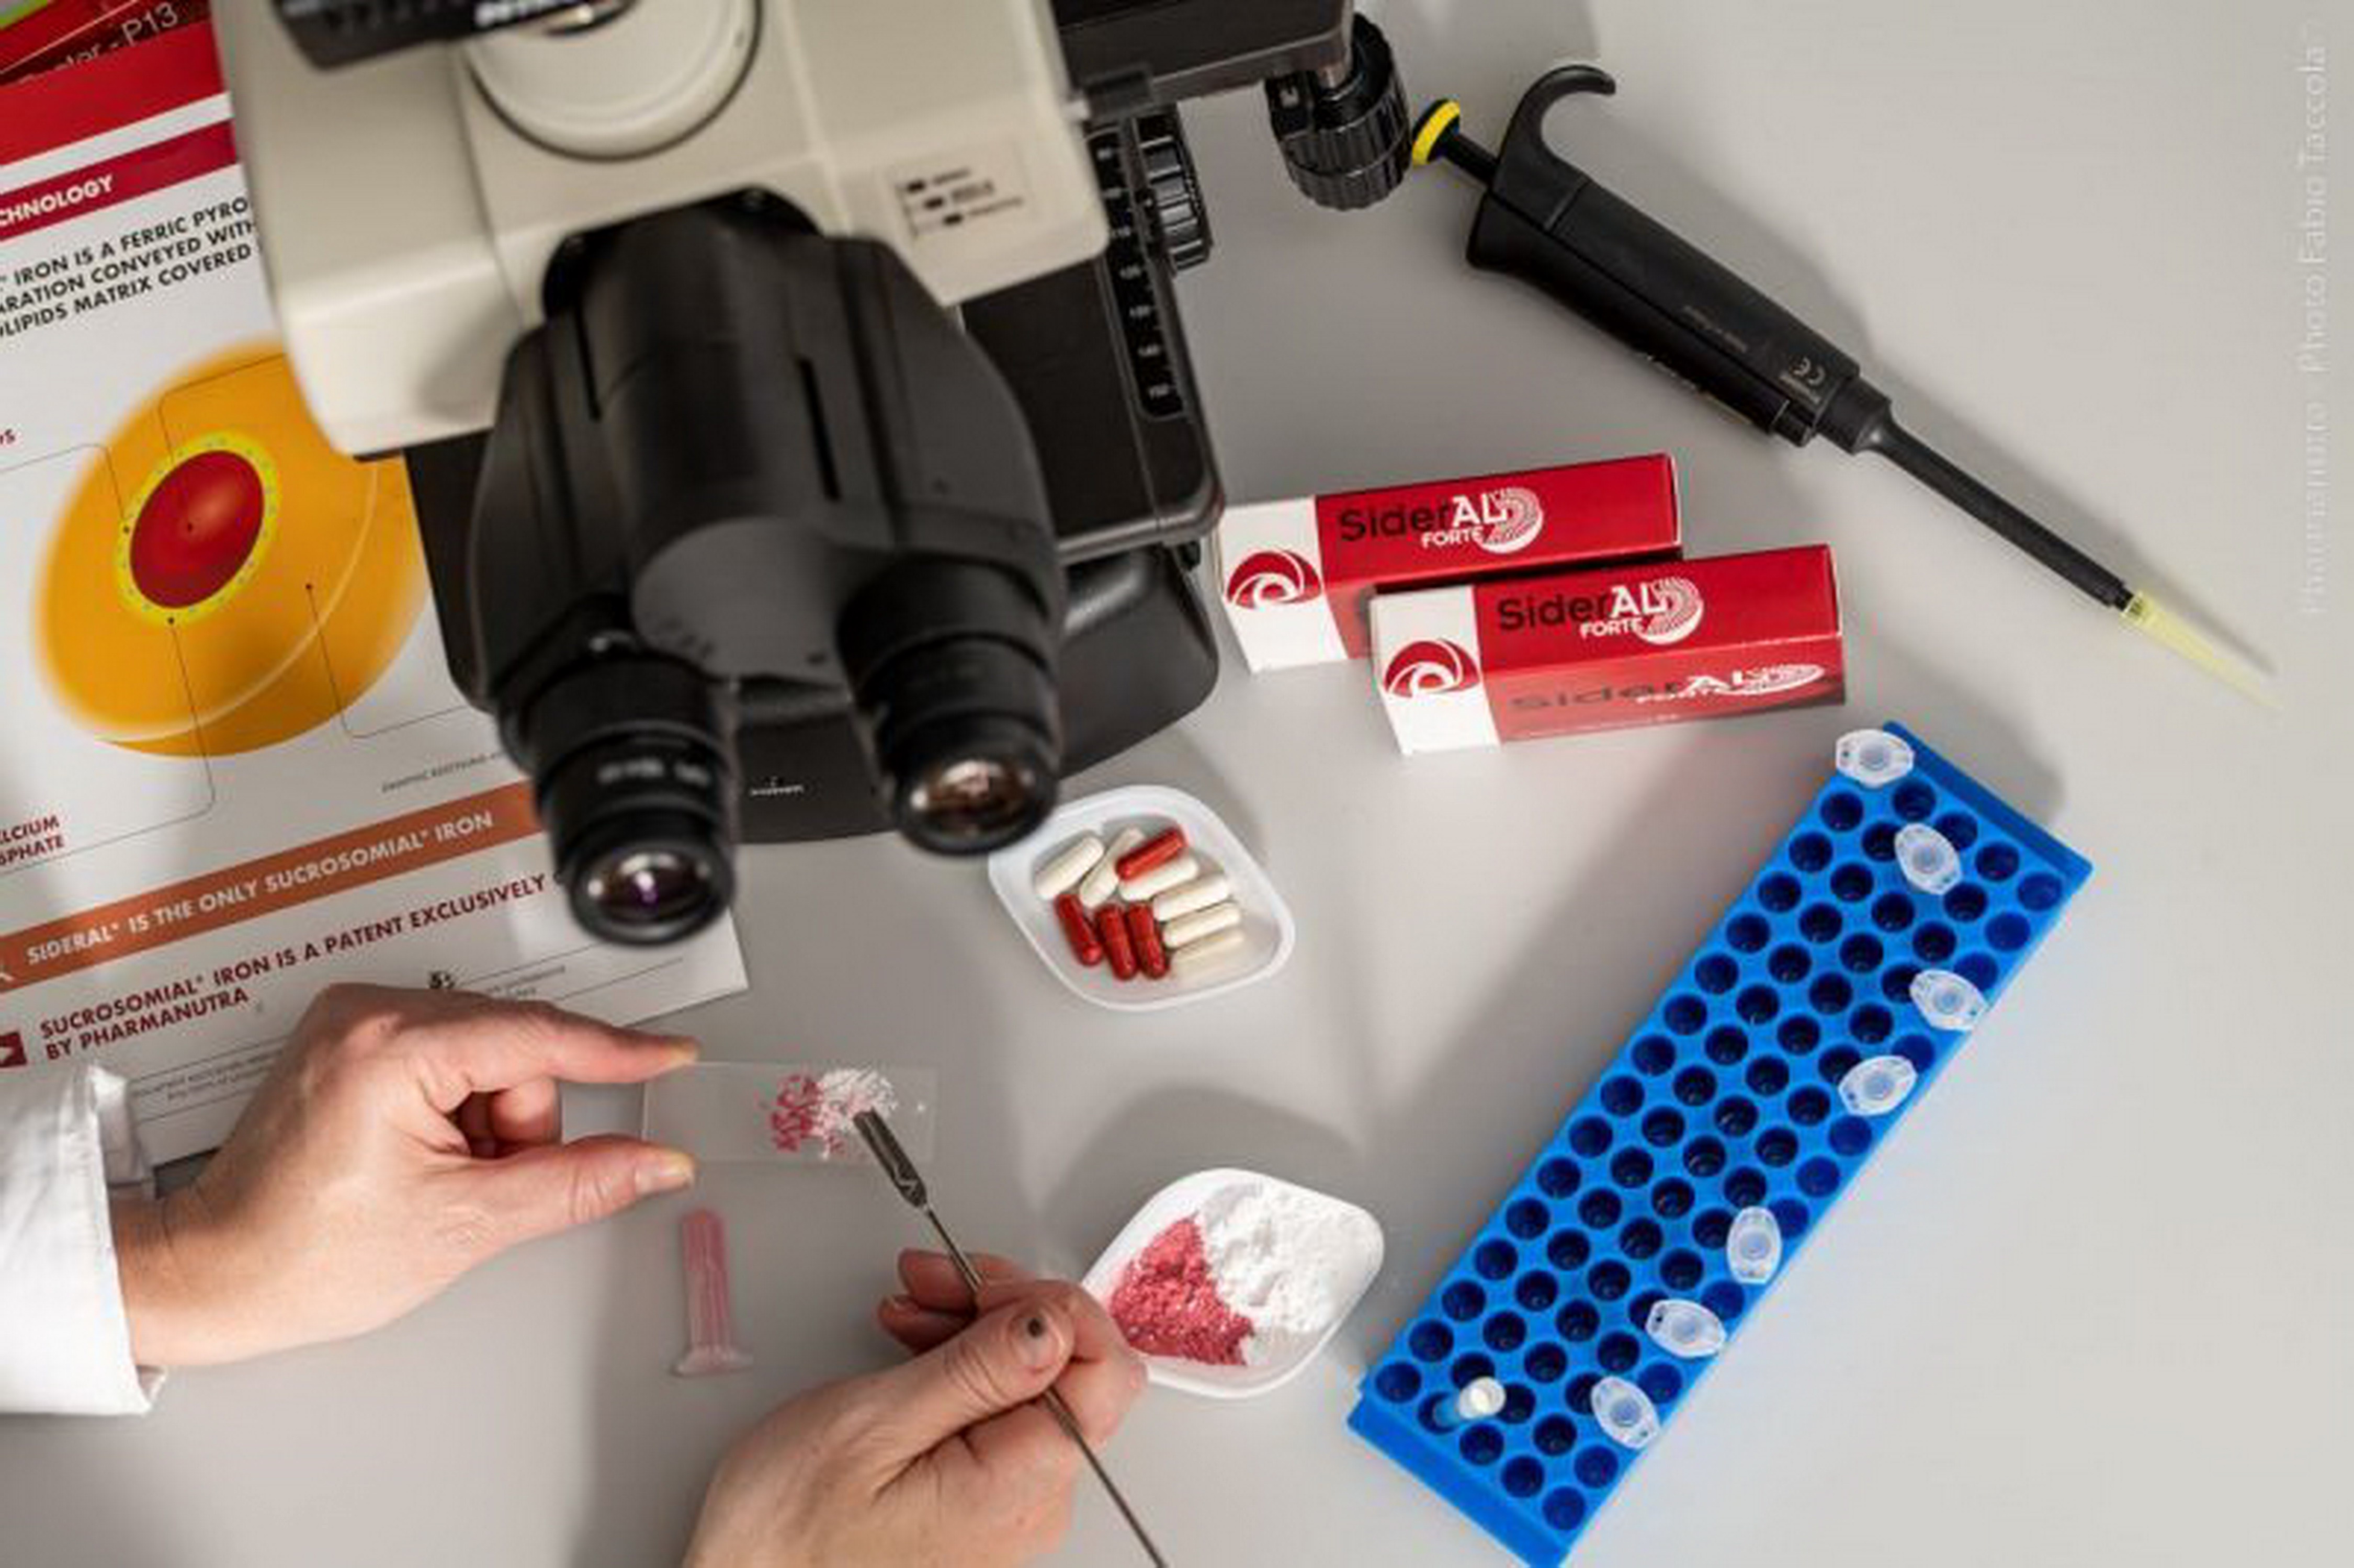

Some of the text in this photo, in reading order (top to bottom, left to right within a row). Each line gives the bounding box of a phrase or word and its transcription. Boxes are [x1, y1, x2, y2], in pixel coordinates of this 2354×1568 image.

[122, 1, 178, 46] P13
[14, 255, 69, 286] IRON
[74, 248, 93, 266] IS
[101, 242, 116, 258] A
[120, 216, 187, 252] FERRIC
[91, 237, 200, 285] CONVEYED
[0, 243, 252, 336] LIPIDS MATRIX COVERED
[1421, 525, 1485, 550] FORTE
[1498, 583, 1667, 631] SiderAL
[1579, 617, 1644, 640] FORTE
[129, 914, 150, 934] IS
[153, 900, 194, 925] THE
[198, 880, 257, 912] ONLY
[434, 811, 494, 844] IRON
[213, 955, 270, 987] IRON
[276, 949, 297, 970] IS
[304, 942, 319, 961] A
[326, 917, 402, 954] PATENT
[411, 874, 546, 928] EXCLUSIVELY
[46, 986, 250, 1061] BY PHARMANUTRA
